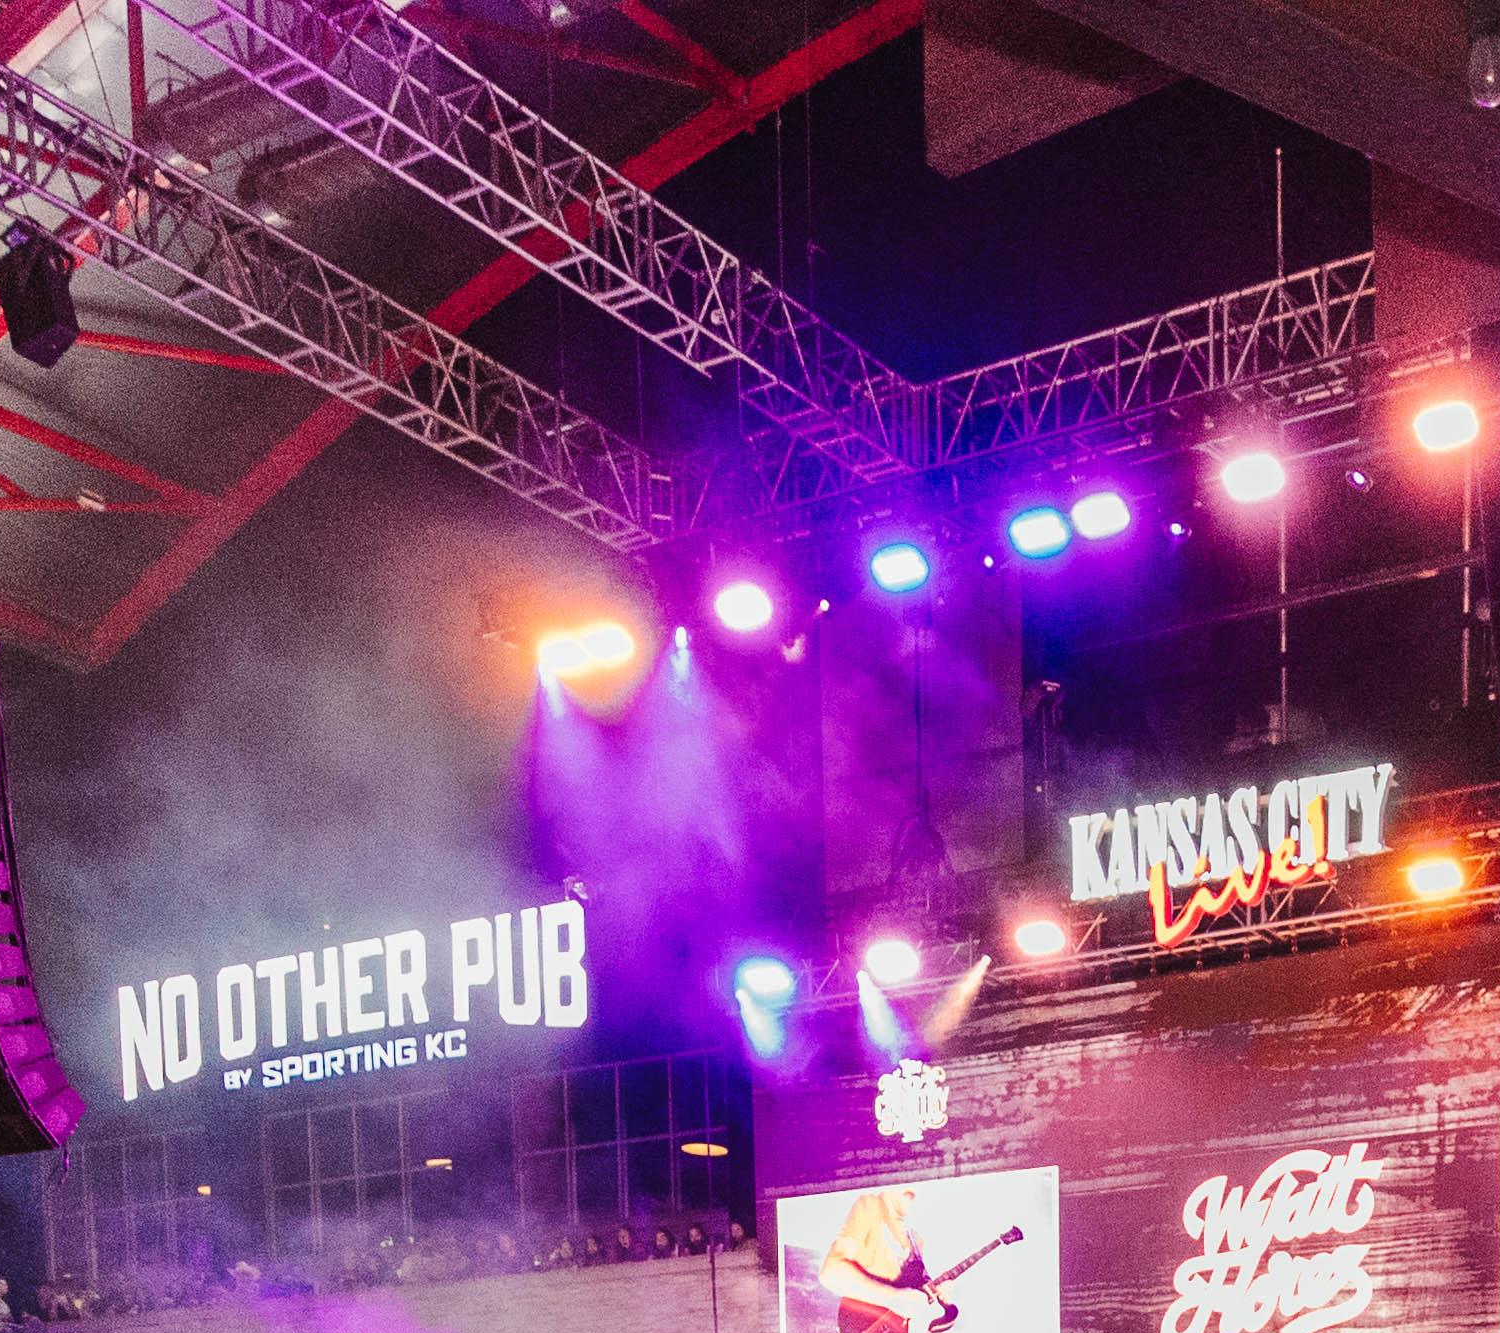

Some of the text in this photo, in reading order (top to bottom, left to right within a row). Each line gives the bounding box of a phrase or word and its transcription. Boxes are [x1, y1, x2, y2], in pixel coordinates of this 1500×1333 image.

[1069, 762, 1395, 902] KANSAS CITY
[117, 899, 588, 1102] NO OTHER PUB
[223, 1029, 467, 1091] BY SPORTING KC
